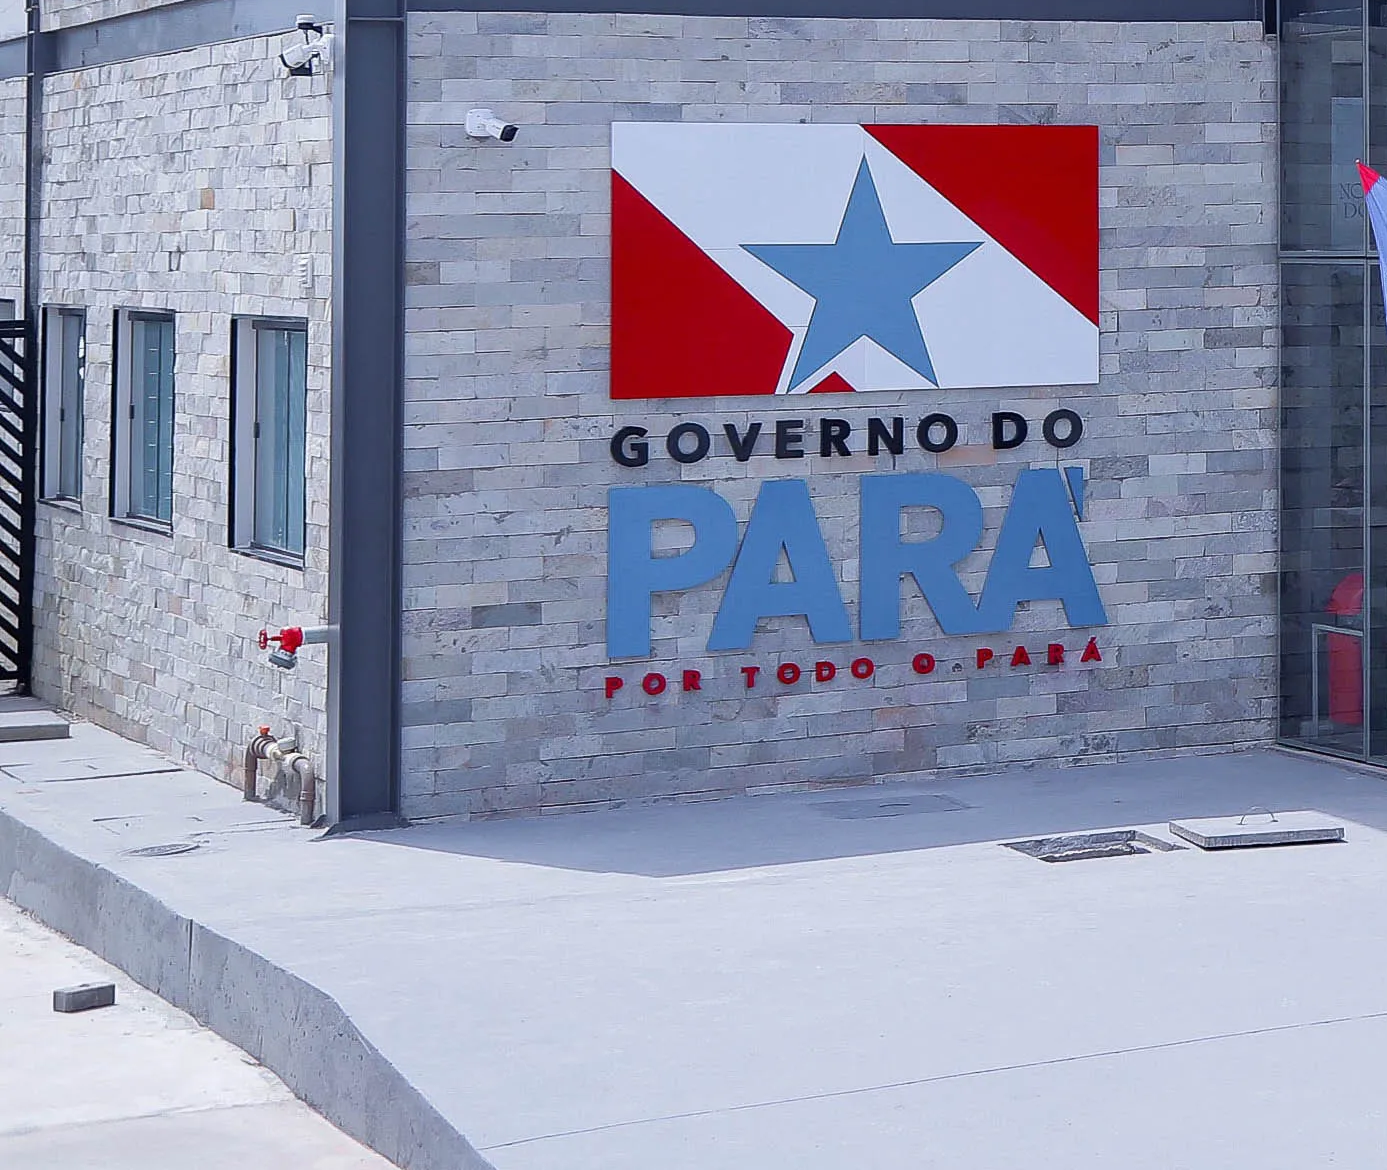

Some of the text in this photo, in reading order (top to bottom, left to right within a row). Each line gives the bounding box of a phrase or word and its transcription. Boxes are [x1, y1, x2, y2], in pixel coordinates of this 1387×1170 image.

[610, 409, 1084, 467] GOVERNO DO
[606, 467, 1109, 659] PARÁ
[605, 636, 1103, 699] POR TODO O PARÁ
